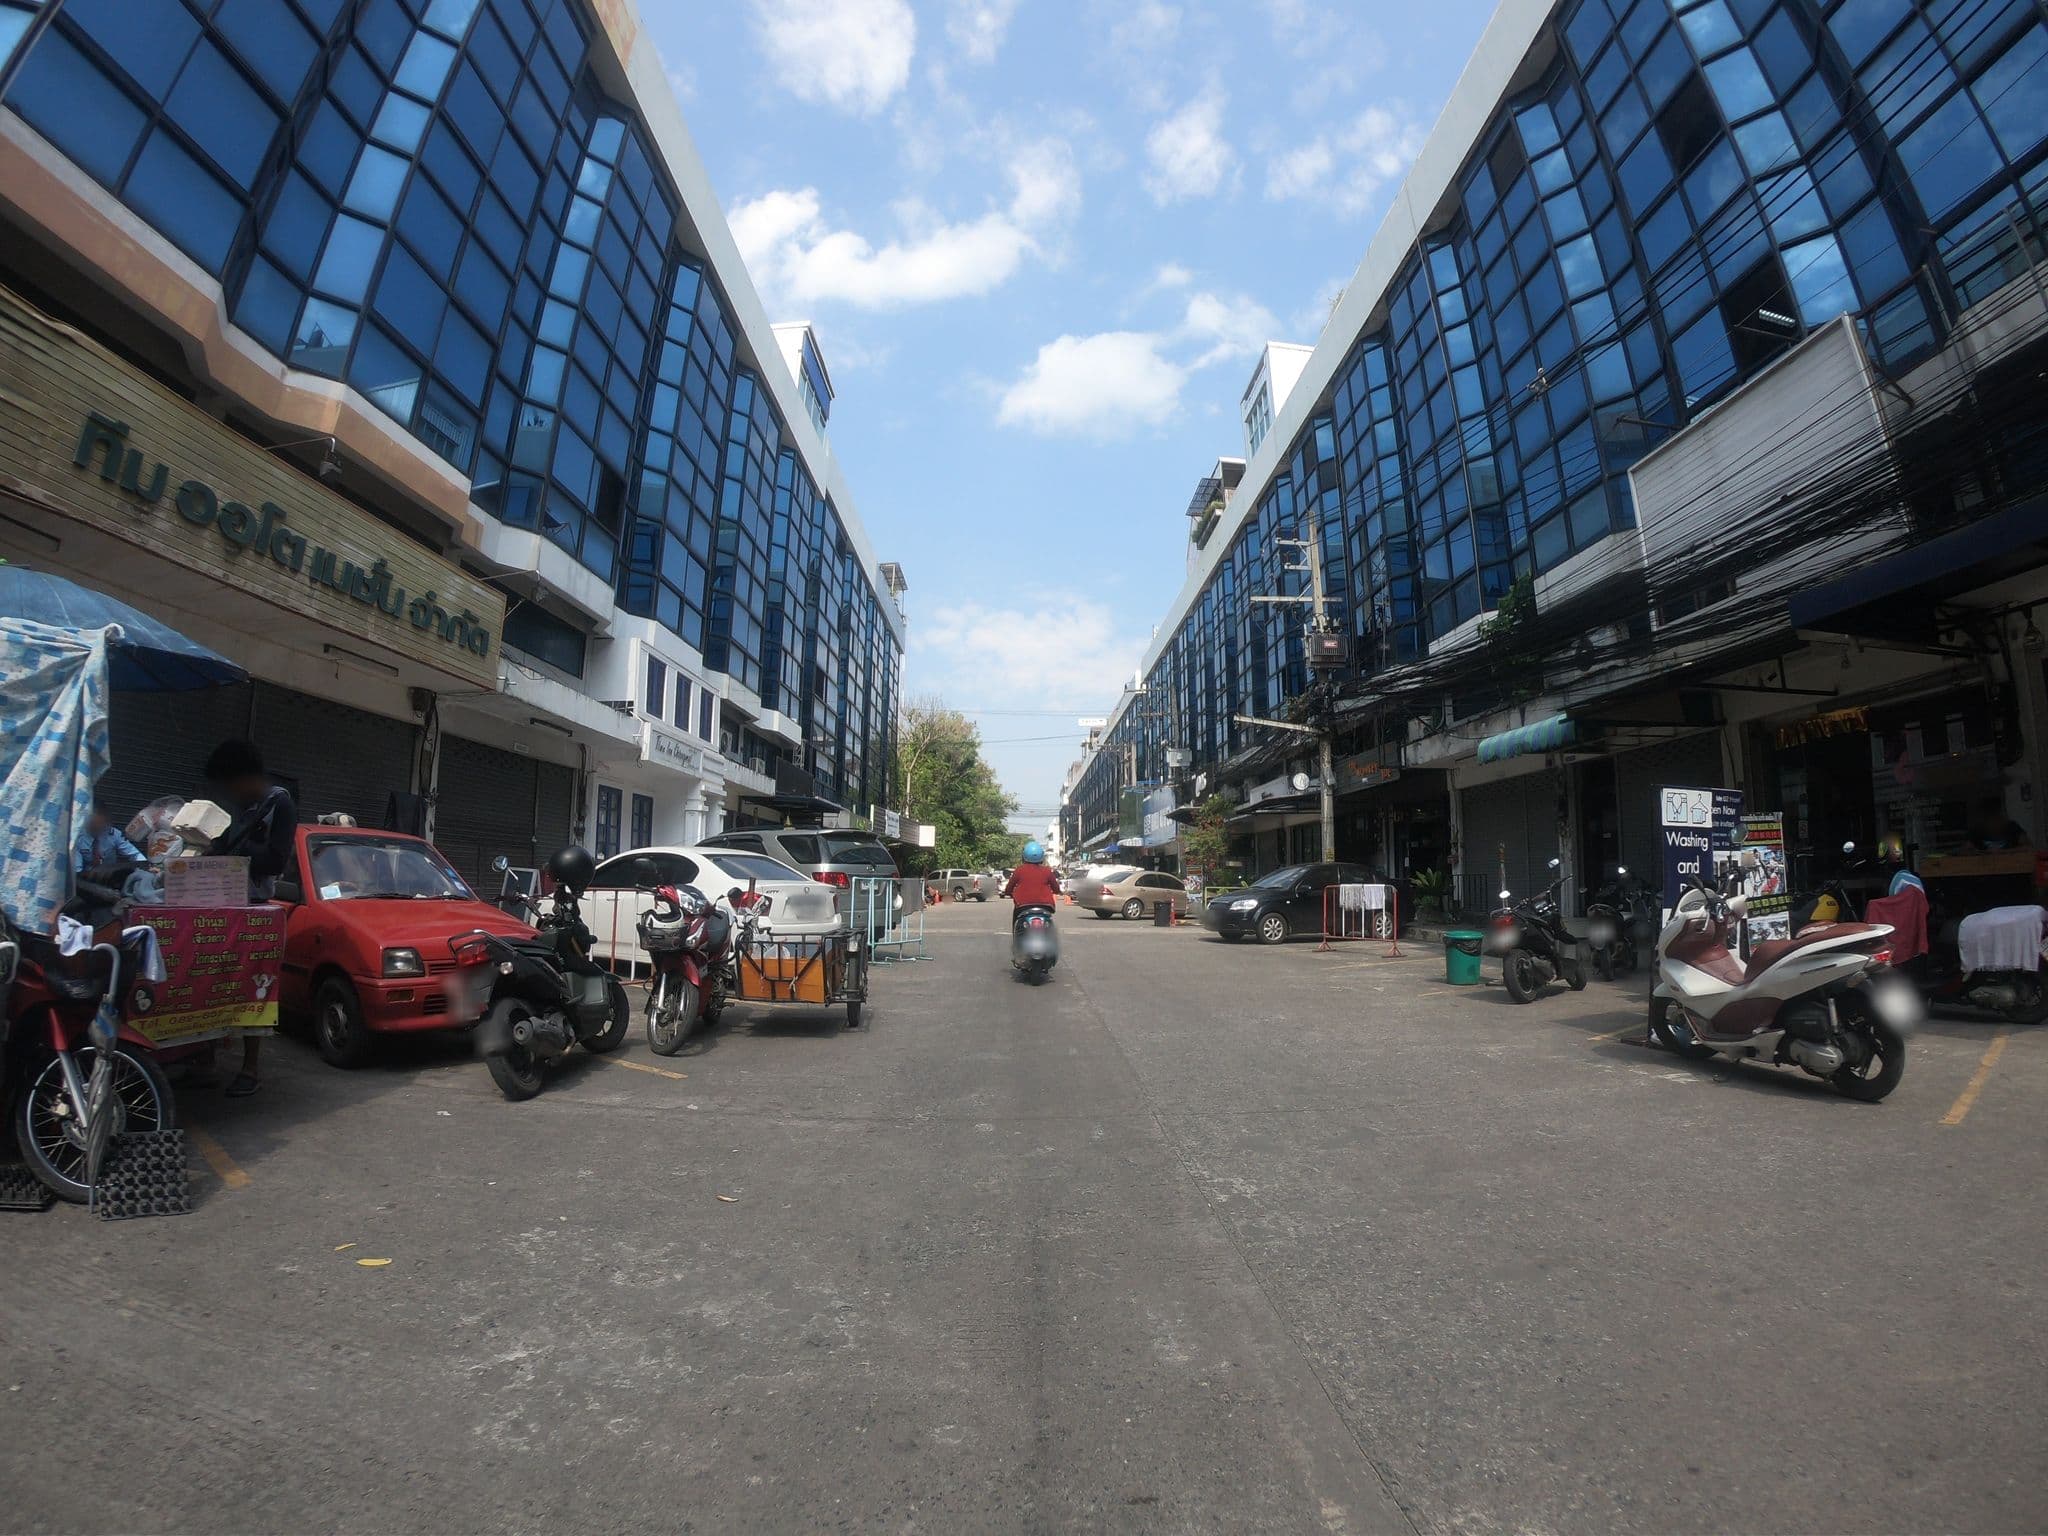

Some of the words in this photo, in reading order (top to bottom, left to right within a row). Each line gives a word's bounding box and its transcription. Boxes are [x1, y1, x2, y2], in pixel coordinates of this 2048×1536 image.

[408, 590, 490, 658] จำกัด
[1665, 832, 1709, 852] Washing
[1677, 855, 1700, 874] and
